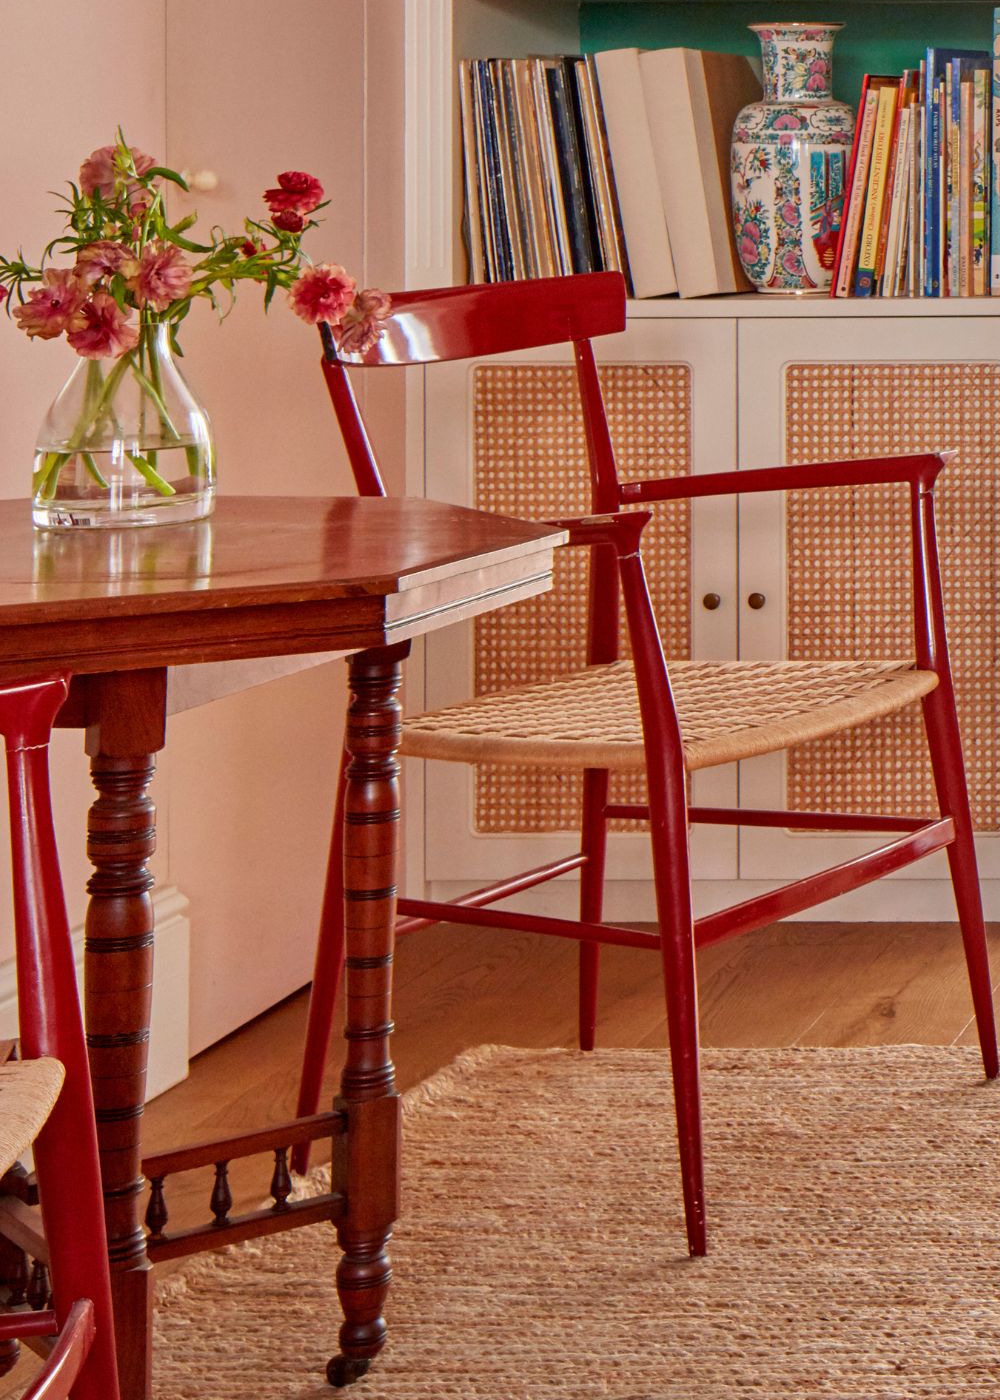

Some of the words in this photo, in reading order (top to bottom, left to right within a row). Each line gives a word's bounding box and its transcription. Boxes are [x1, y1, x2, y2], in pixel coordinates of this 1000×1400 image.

[875, 132, 885, 167] HISTORY
[871, 167, 882, 202] ANCIENT
[863, 234, 873, 267] OXFORD
